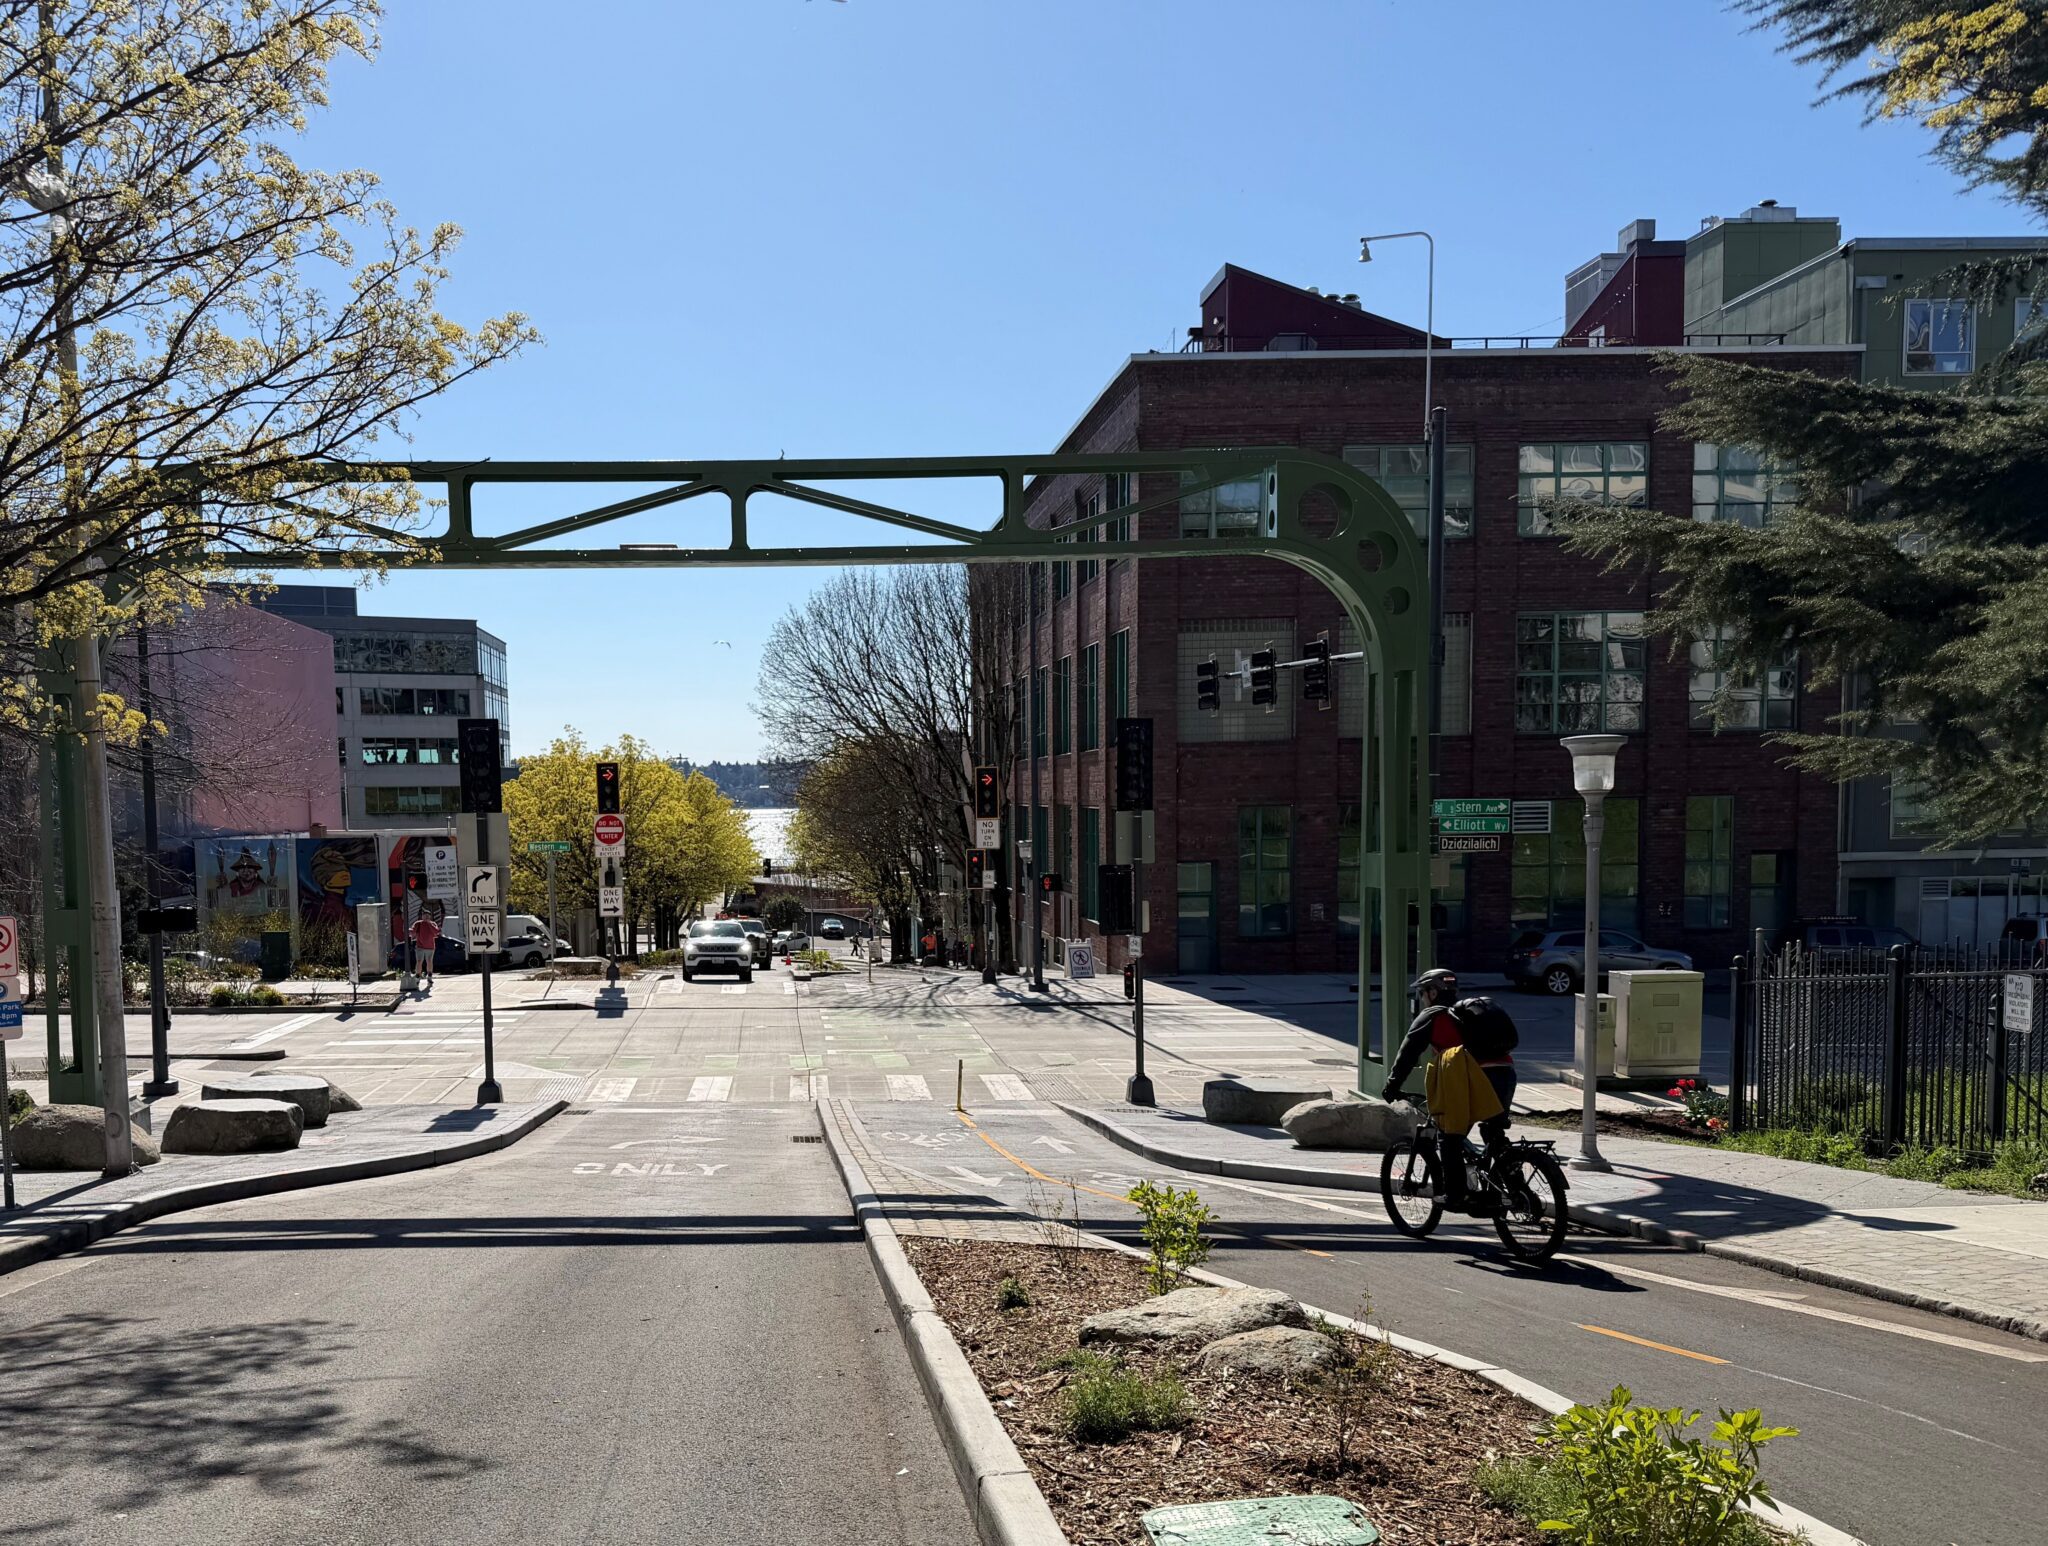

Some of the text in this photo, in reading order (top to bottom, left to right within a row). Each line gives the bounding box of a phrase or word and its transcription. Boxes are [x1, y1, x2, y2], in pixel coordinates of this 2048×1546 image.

[1456, 802, 1481, 812] stern
[1454, 819, 1506, 832] Elliott Wy
[1441, 838, 1497, 850] Dzidzilalich
[470, 895, 495, 904] ONLY
[471, 914, 495, 925] ONE
[471, 926, 495, 936] WAY
